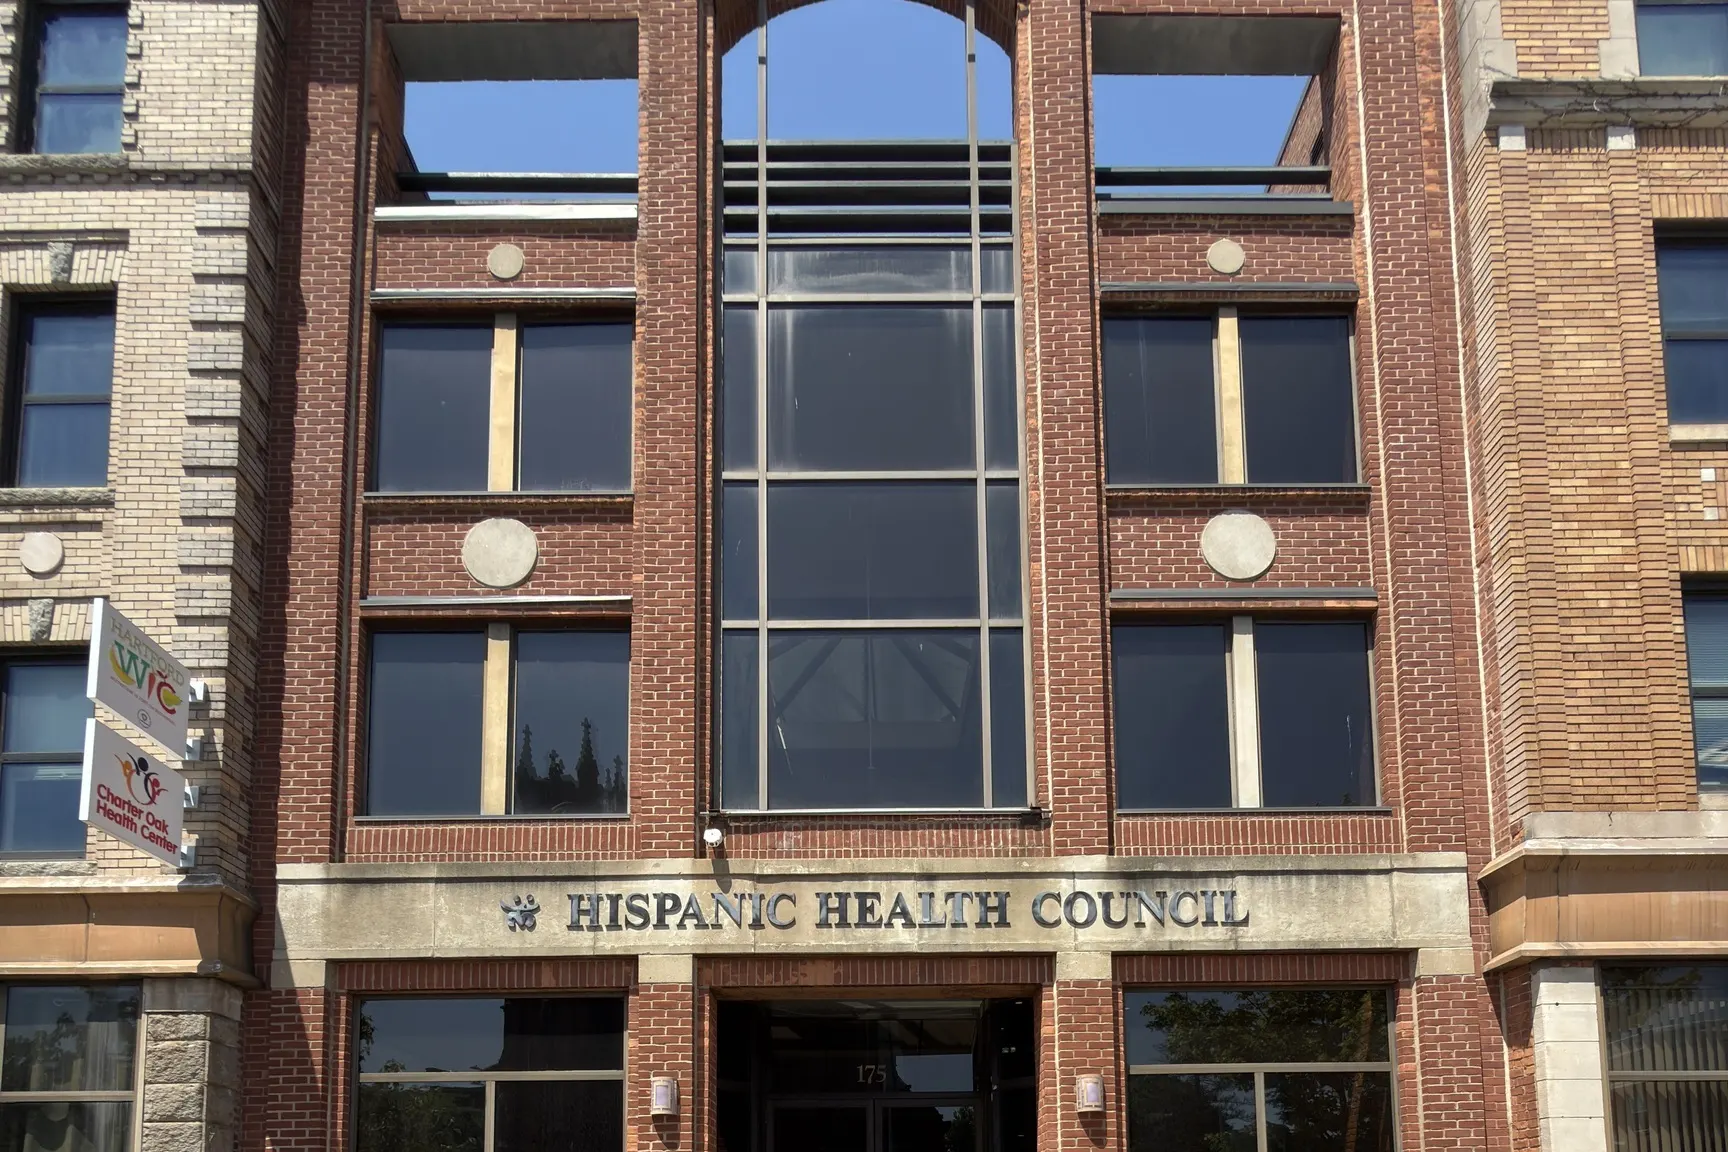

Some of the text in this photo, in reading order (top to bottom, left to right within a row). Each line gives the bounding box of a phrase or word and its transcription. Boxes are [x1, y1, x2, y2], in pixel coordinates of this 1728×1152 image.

[110, 617, 184, 688] HARTFORD
[113, 640, 177, 716] WIC
[95, 801, 179, 855] Health Center
[96, 783, 170, 835] Charter Oak
[566, 890, 1251, 932] HISPANIC HEALTH COUNCIL
[856, 1064, 887, 1084] 175
